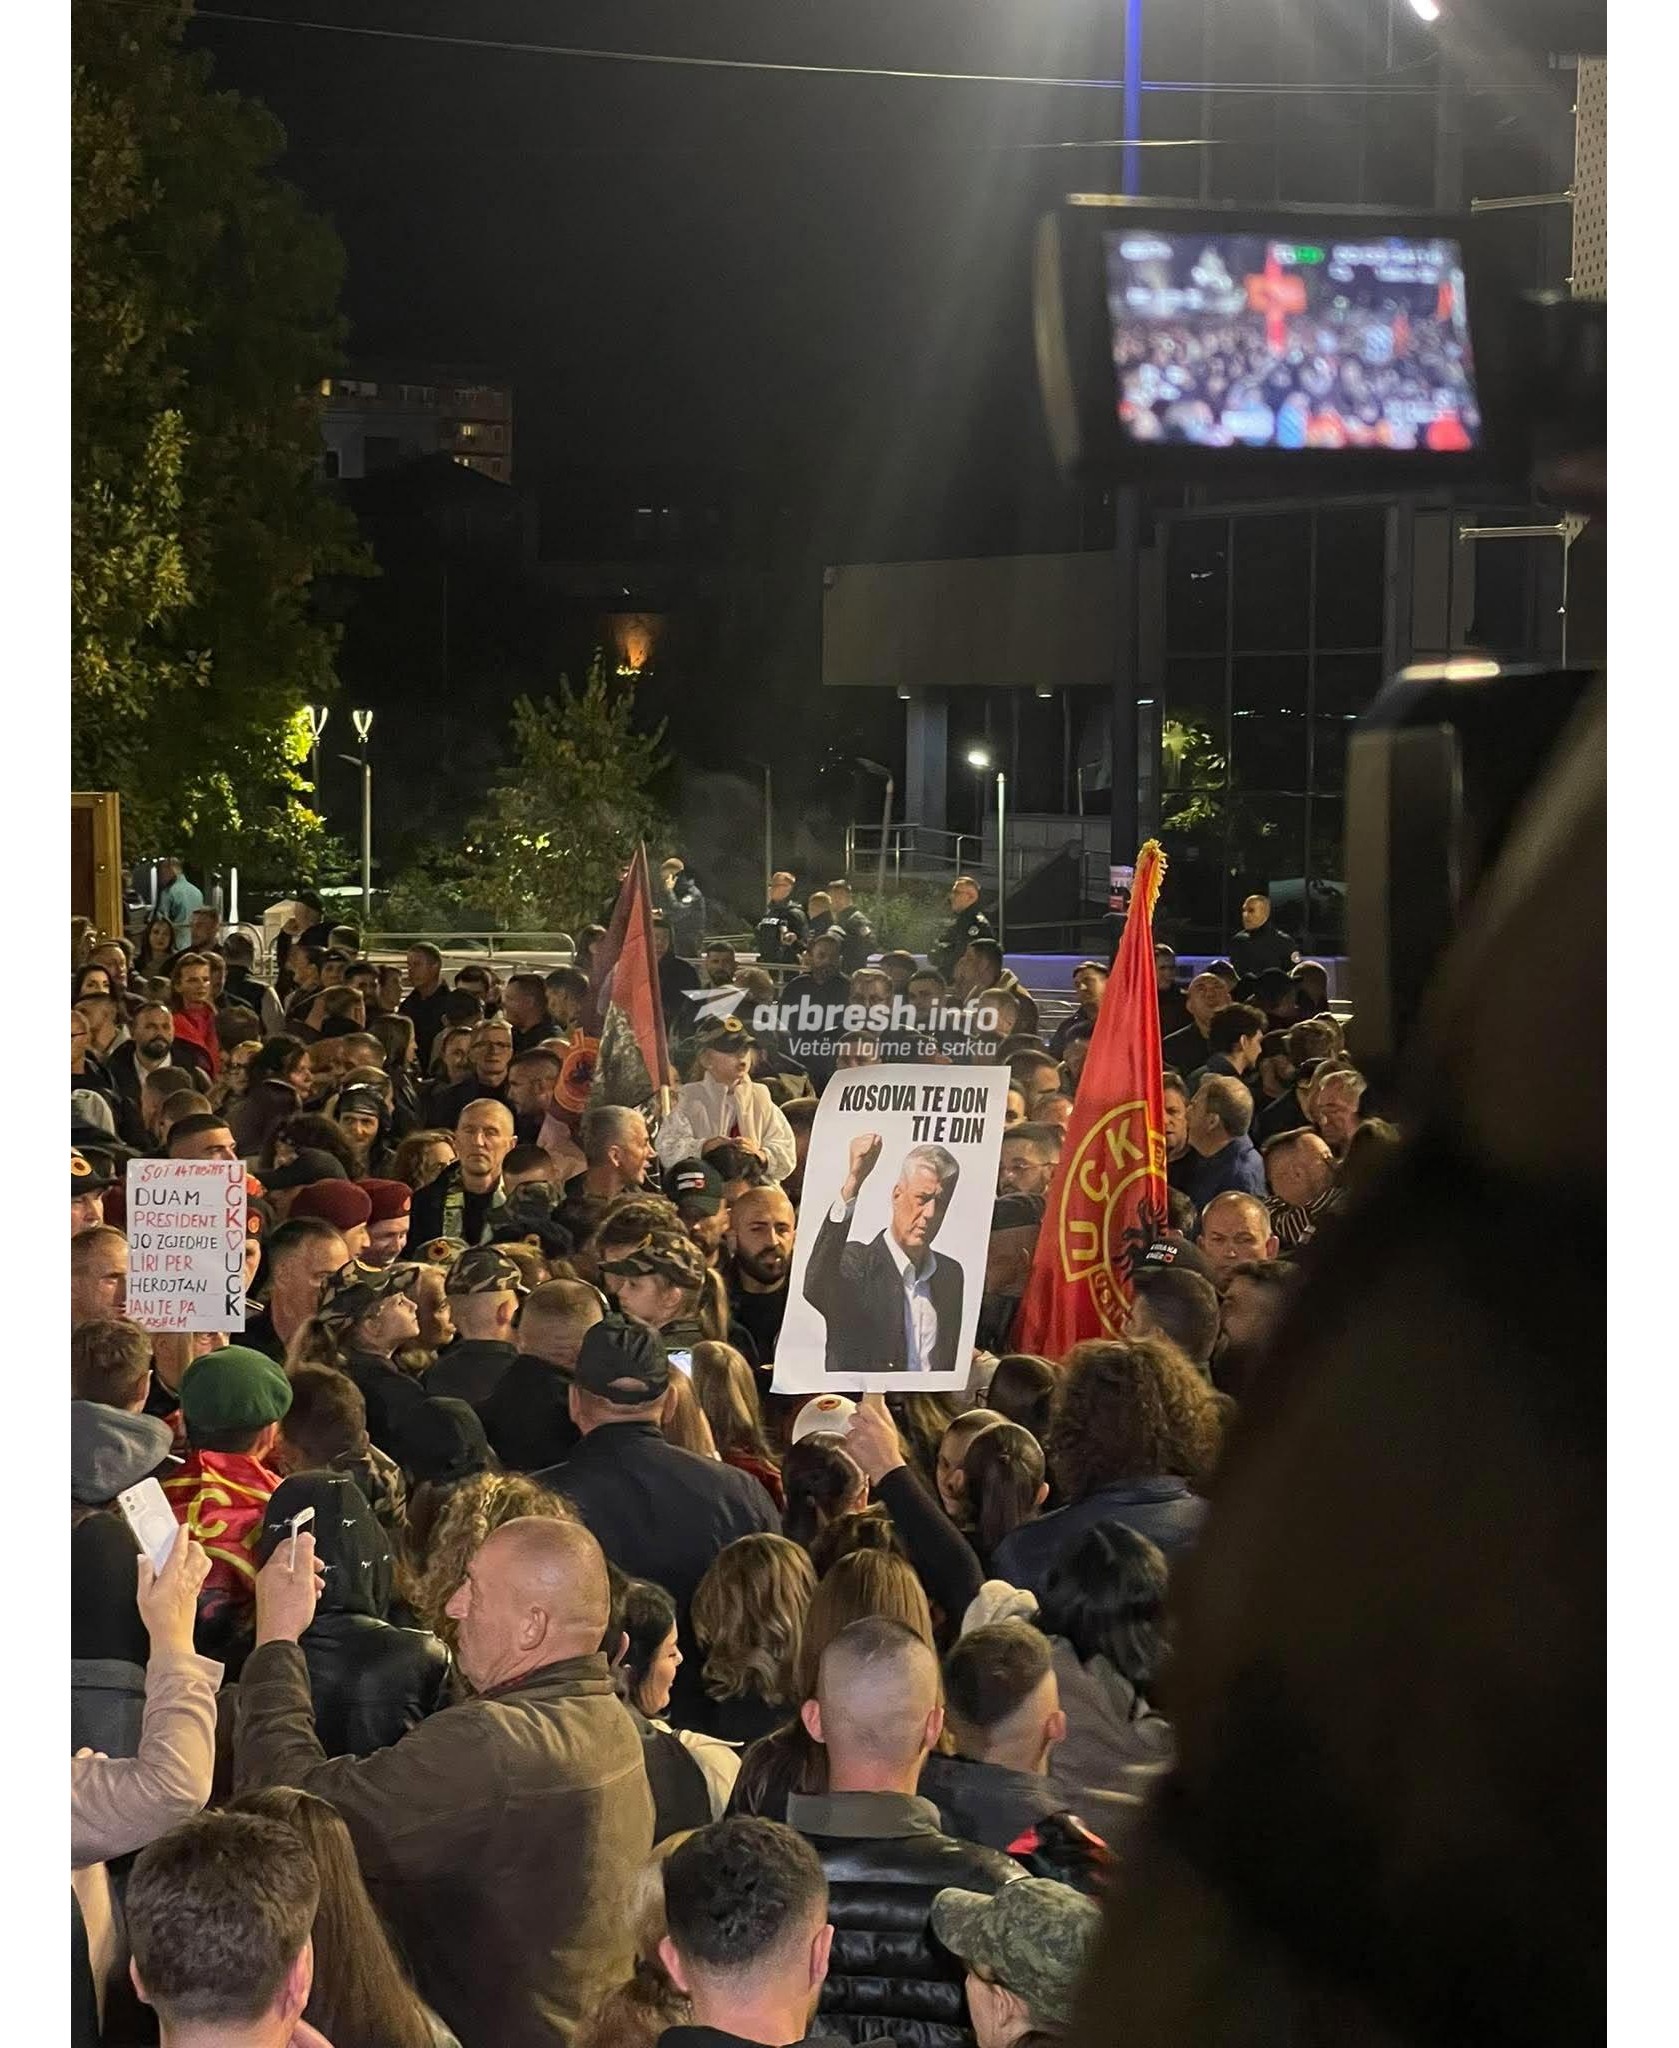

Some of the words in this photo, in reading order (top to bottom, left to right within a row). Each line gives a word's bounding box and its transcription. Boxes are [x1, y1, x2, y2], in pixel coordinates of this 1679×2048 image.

[839, 1085, 915, 1112] KOSOVA
[921, 1086, 948, 1113] TE
[950, 1086, 989, 1114] DON
[912, 1115, 931, 1142] TI
[933, 1116, 946, 1142] E
[948, 1117, 985, 1144] DIN
[135, 1187, 200, 1206] DUAM
[134, 1211, 218, 1228] PRESIDENT
[131, 1233, 152, 1250] JO
[157, 1234, 218, 1249] ZGJEDHJE
[130, 1254, 158, 1272] LIRI
[165, 1255, 193, 1272] PER
[179, 1300, 197, 1315] PA
